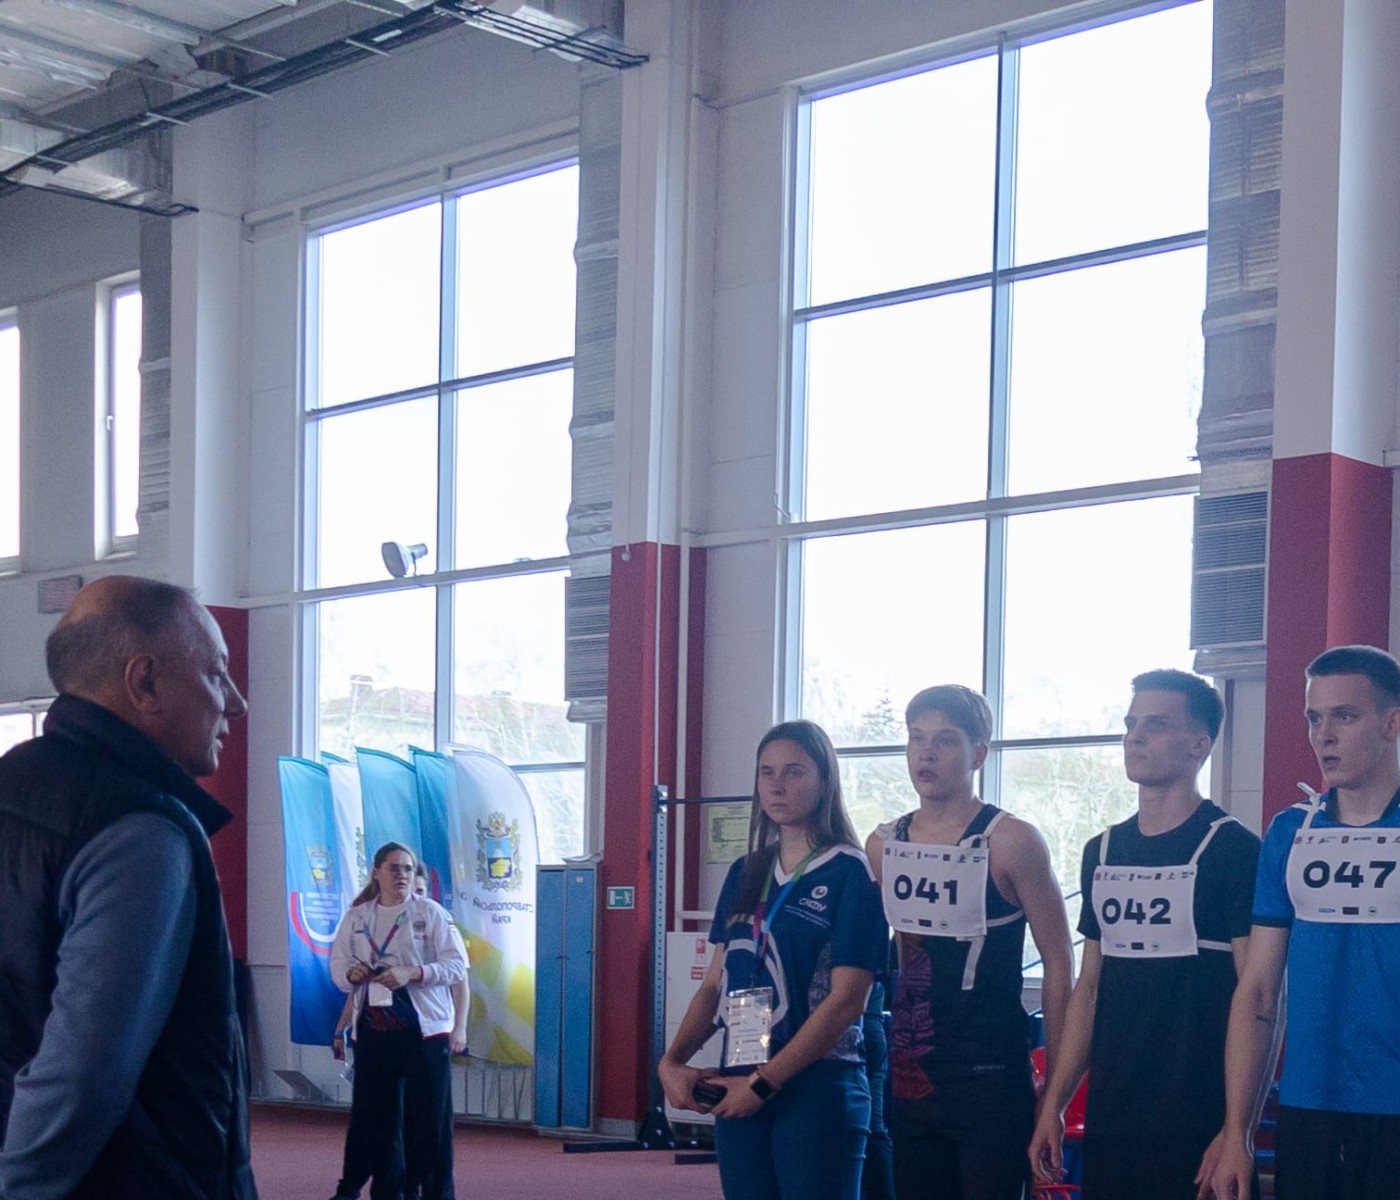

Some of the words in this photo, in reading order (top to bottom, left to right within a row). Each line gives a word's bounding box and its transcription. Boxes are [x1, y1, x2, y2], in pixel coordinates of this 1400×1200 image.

[1303, 860, 1397, 888] 047
[894, 874, 958, 905] 041
[1102, 897, 1171, 925] 042
